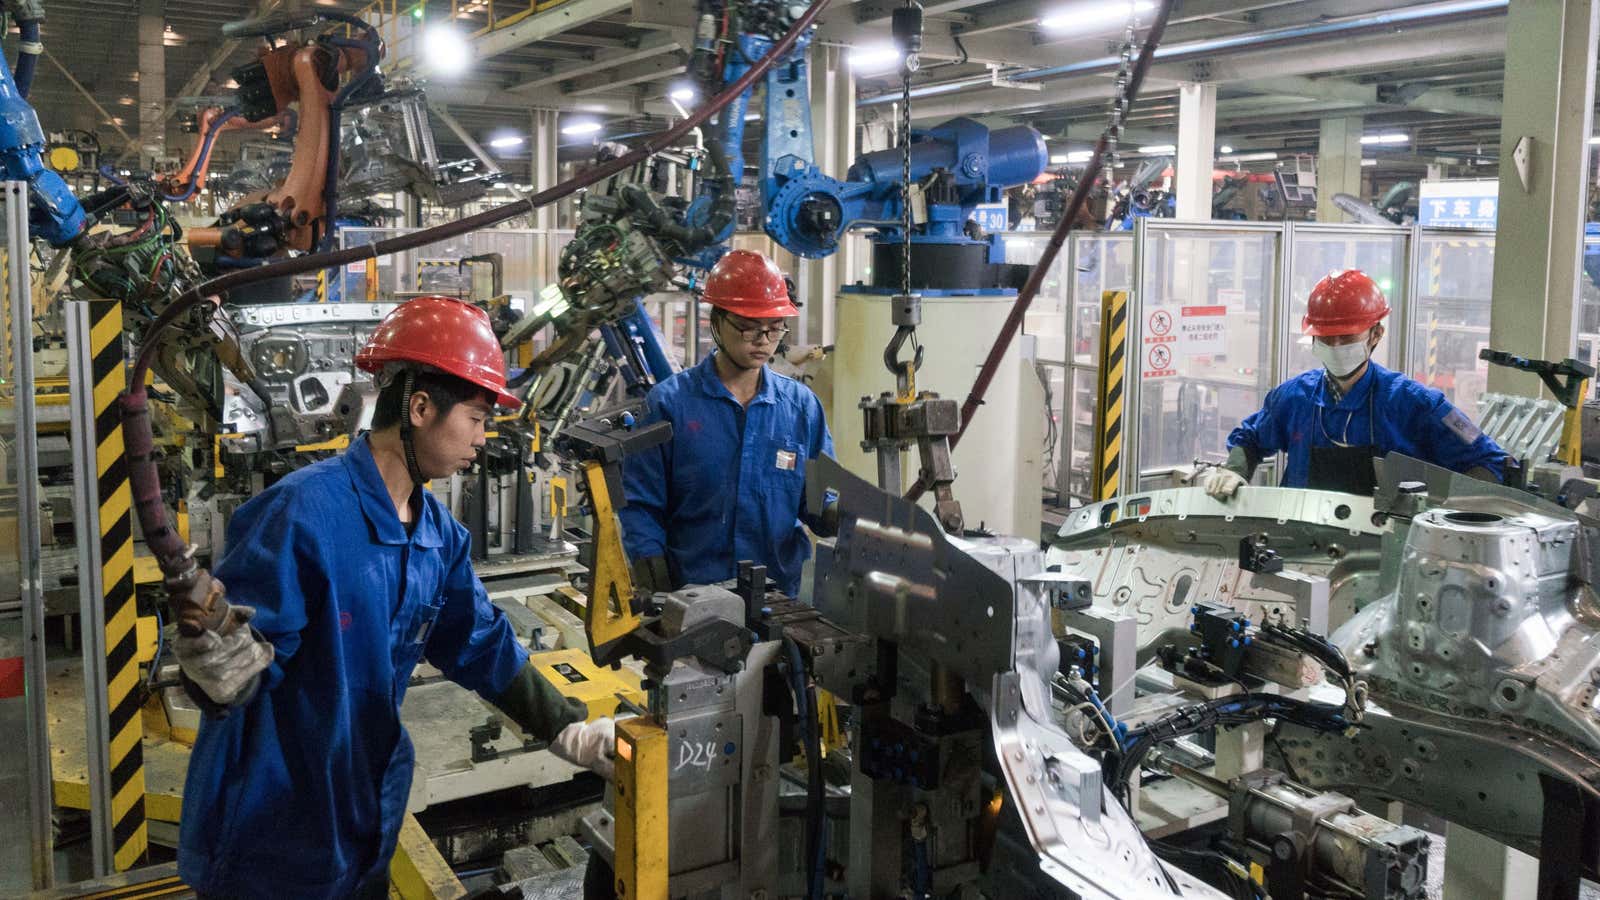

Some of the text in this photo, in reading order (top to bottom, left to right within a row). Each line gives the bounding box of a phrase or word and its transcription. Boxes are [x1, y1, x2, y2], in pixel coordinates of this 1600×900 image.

[1429, 199, 1496, 218] 下车身
[990, 213, 1003, 229] 30
[674, 740, 717, 771] D24
